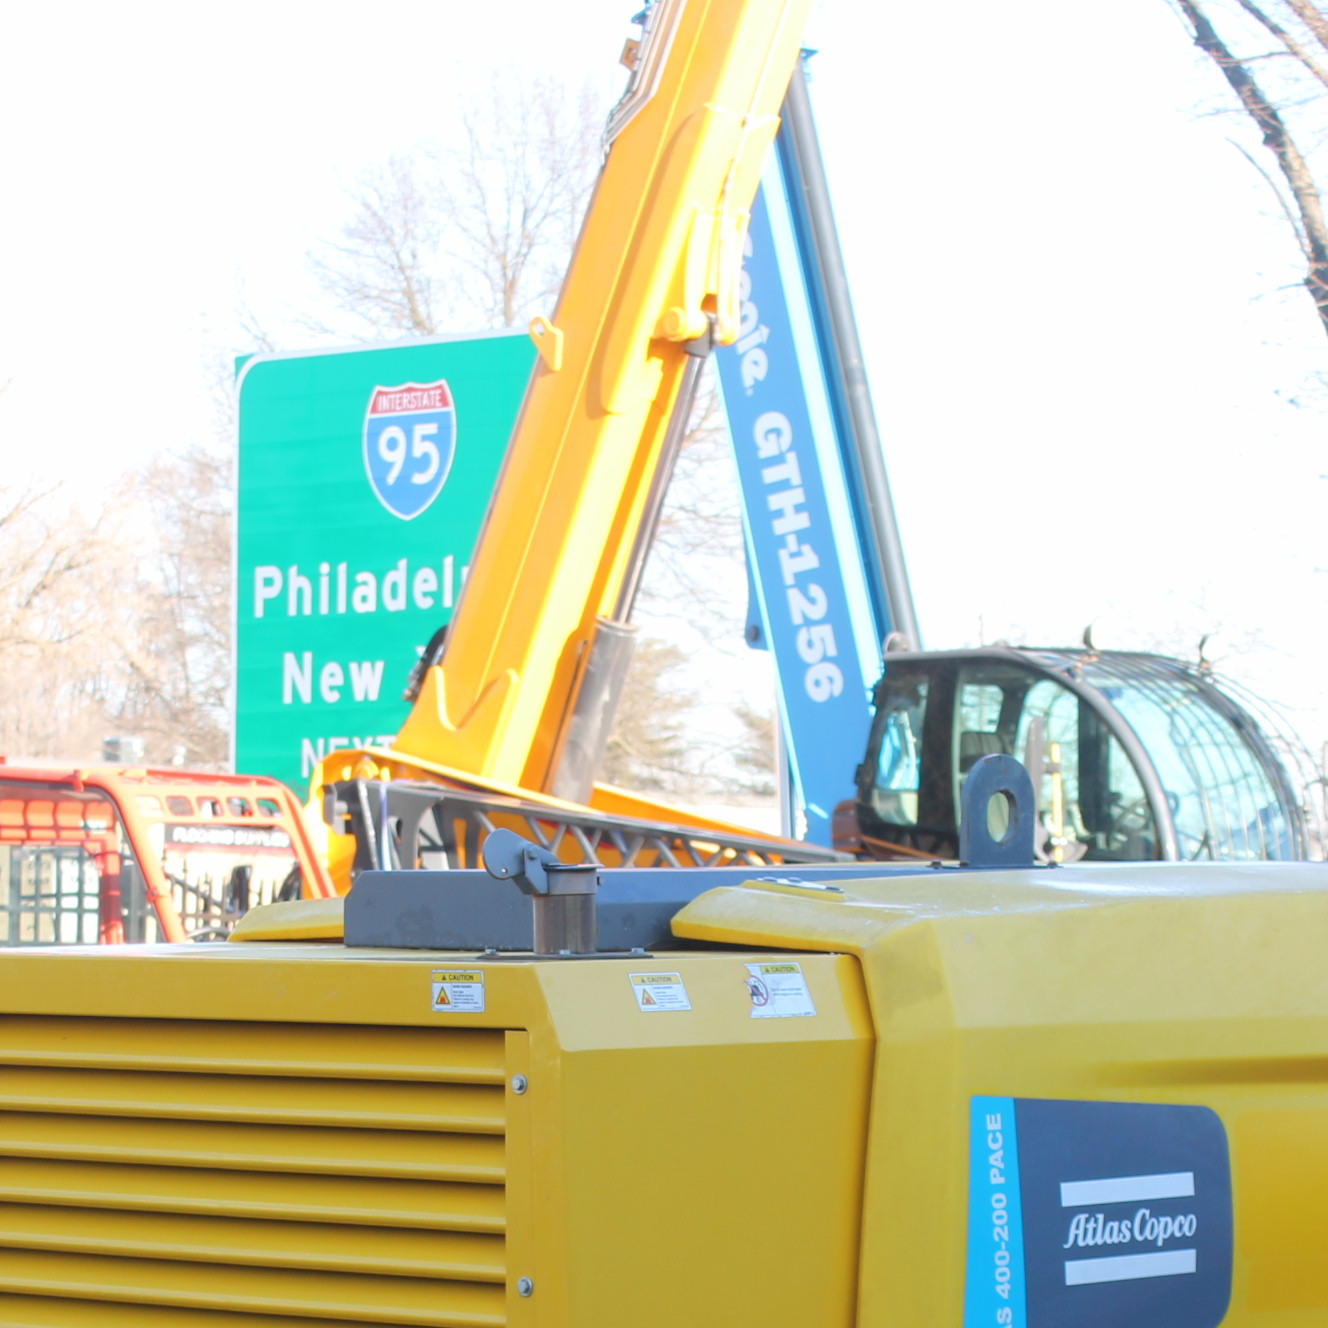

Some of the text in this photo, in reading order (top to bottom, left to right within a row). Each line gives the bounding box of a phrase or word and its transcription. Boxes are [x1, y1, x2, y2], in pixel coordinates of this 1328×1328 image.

[377, 386, 443, 412] INTERSTATE
[377, 422, 440, 486] 95
[253, 555, 470, 619] Philadel
[753, 411, 844, 703] GTH-1256
[282, 651, 384, 704] New
[986, 1113, 1006, 1185] PACE
[991, 1193, 1012, 1299] 400-200
[1063, 1208, 1197, 1249] Atlas Copco
